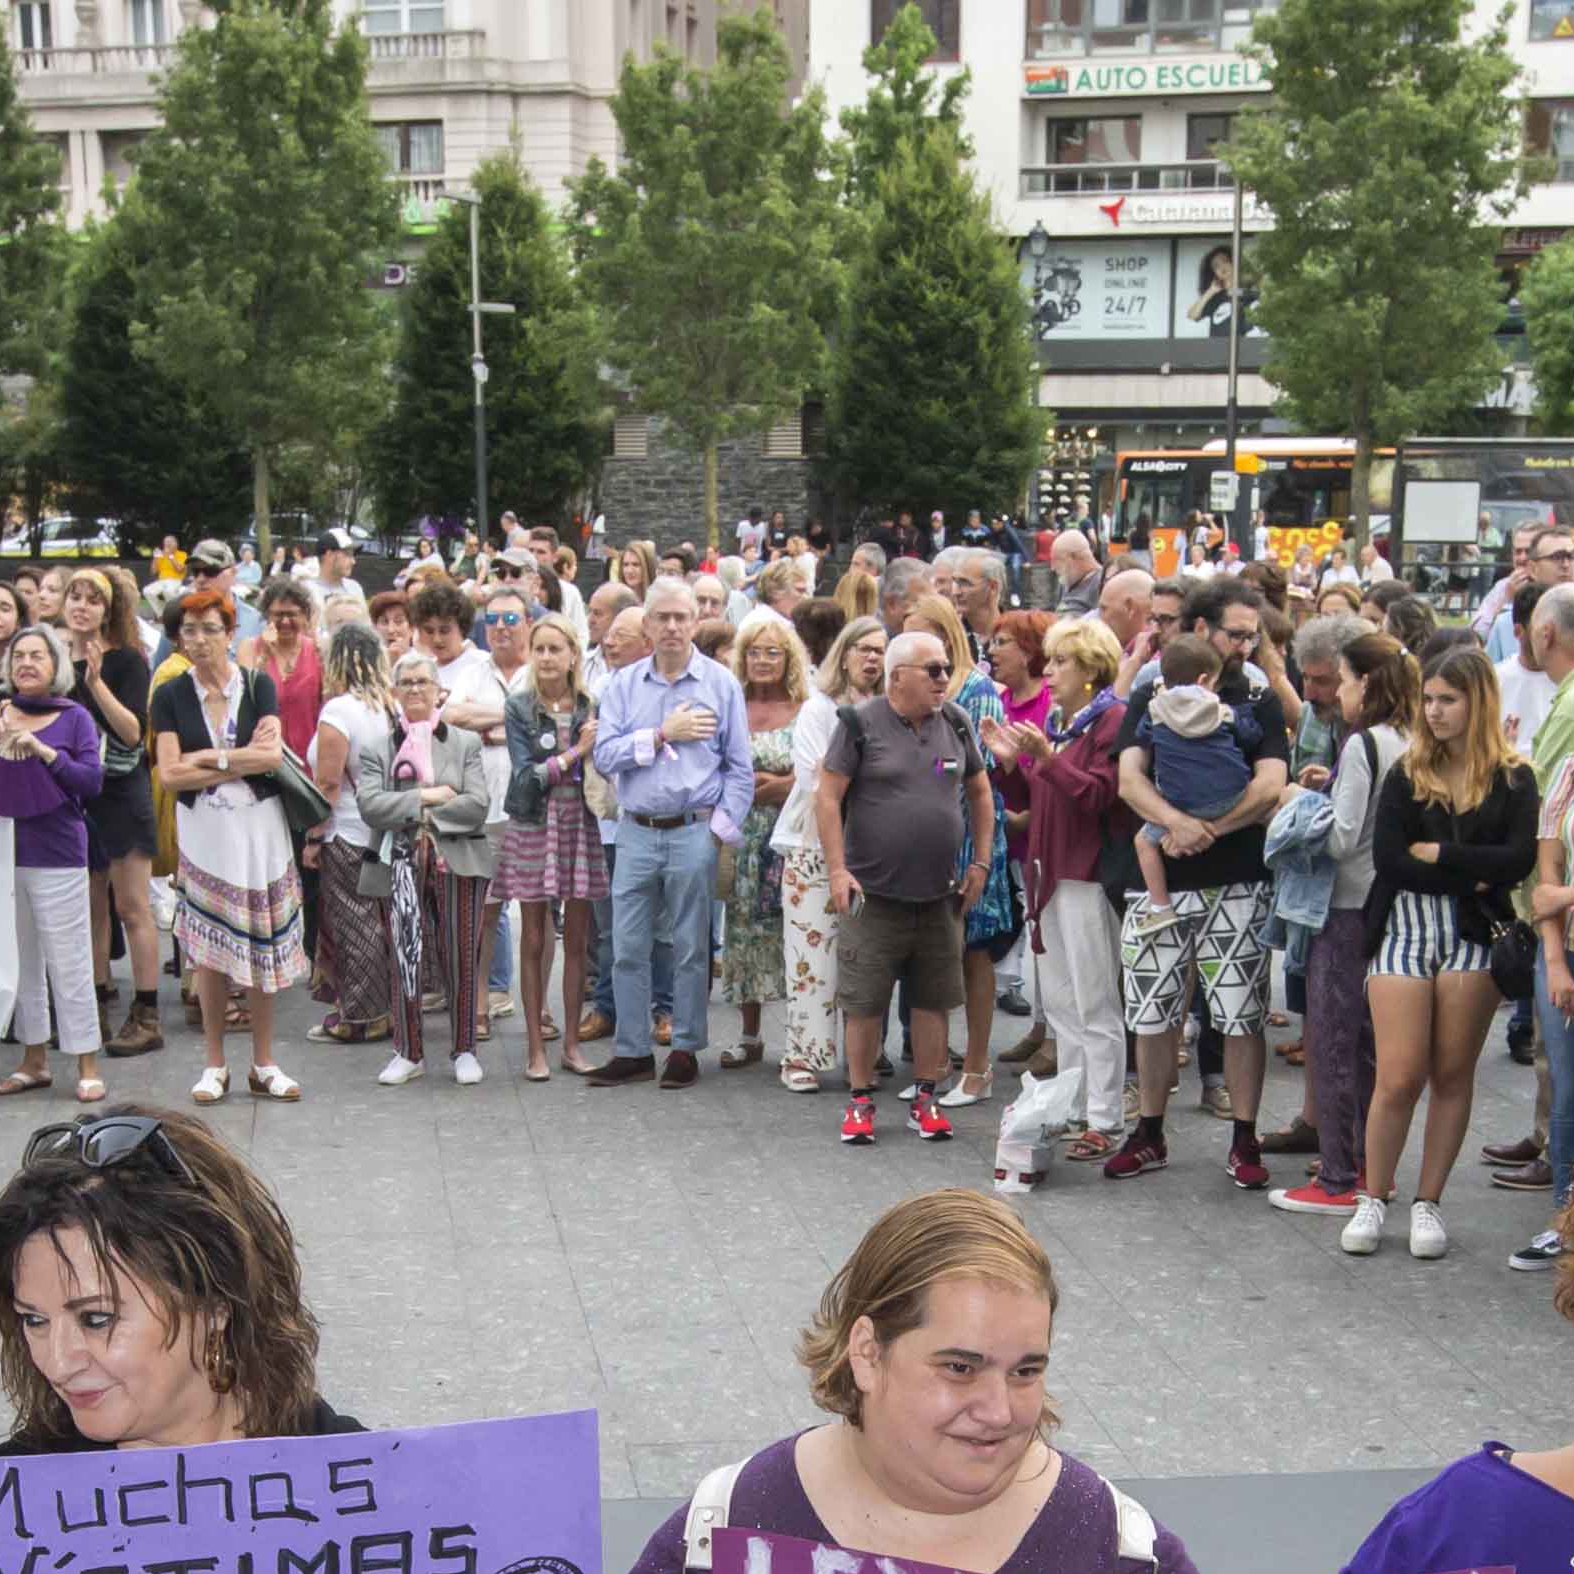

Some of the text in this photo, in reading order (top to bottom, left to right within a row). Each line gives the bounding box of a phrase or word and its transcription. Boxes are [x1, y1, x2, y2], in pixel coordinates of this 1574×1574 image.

[1075, 62, 1273, 90] AUTO ESCUELA
[1104, 256, 1149, 272] SHOP
[1104, 277, 1148, 289] ONLINE
[1104, 296, 1148, 315] 24/7
